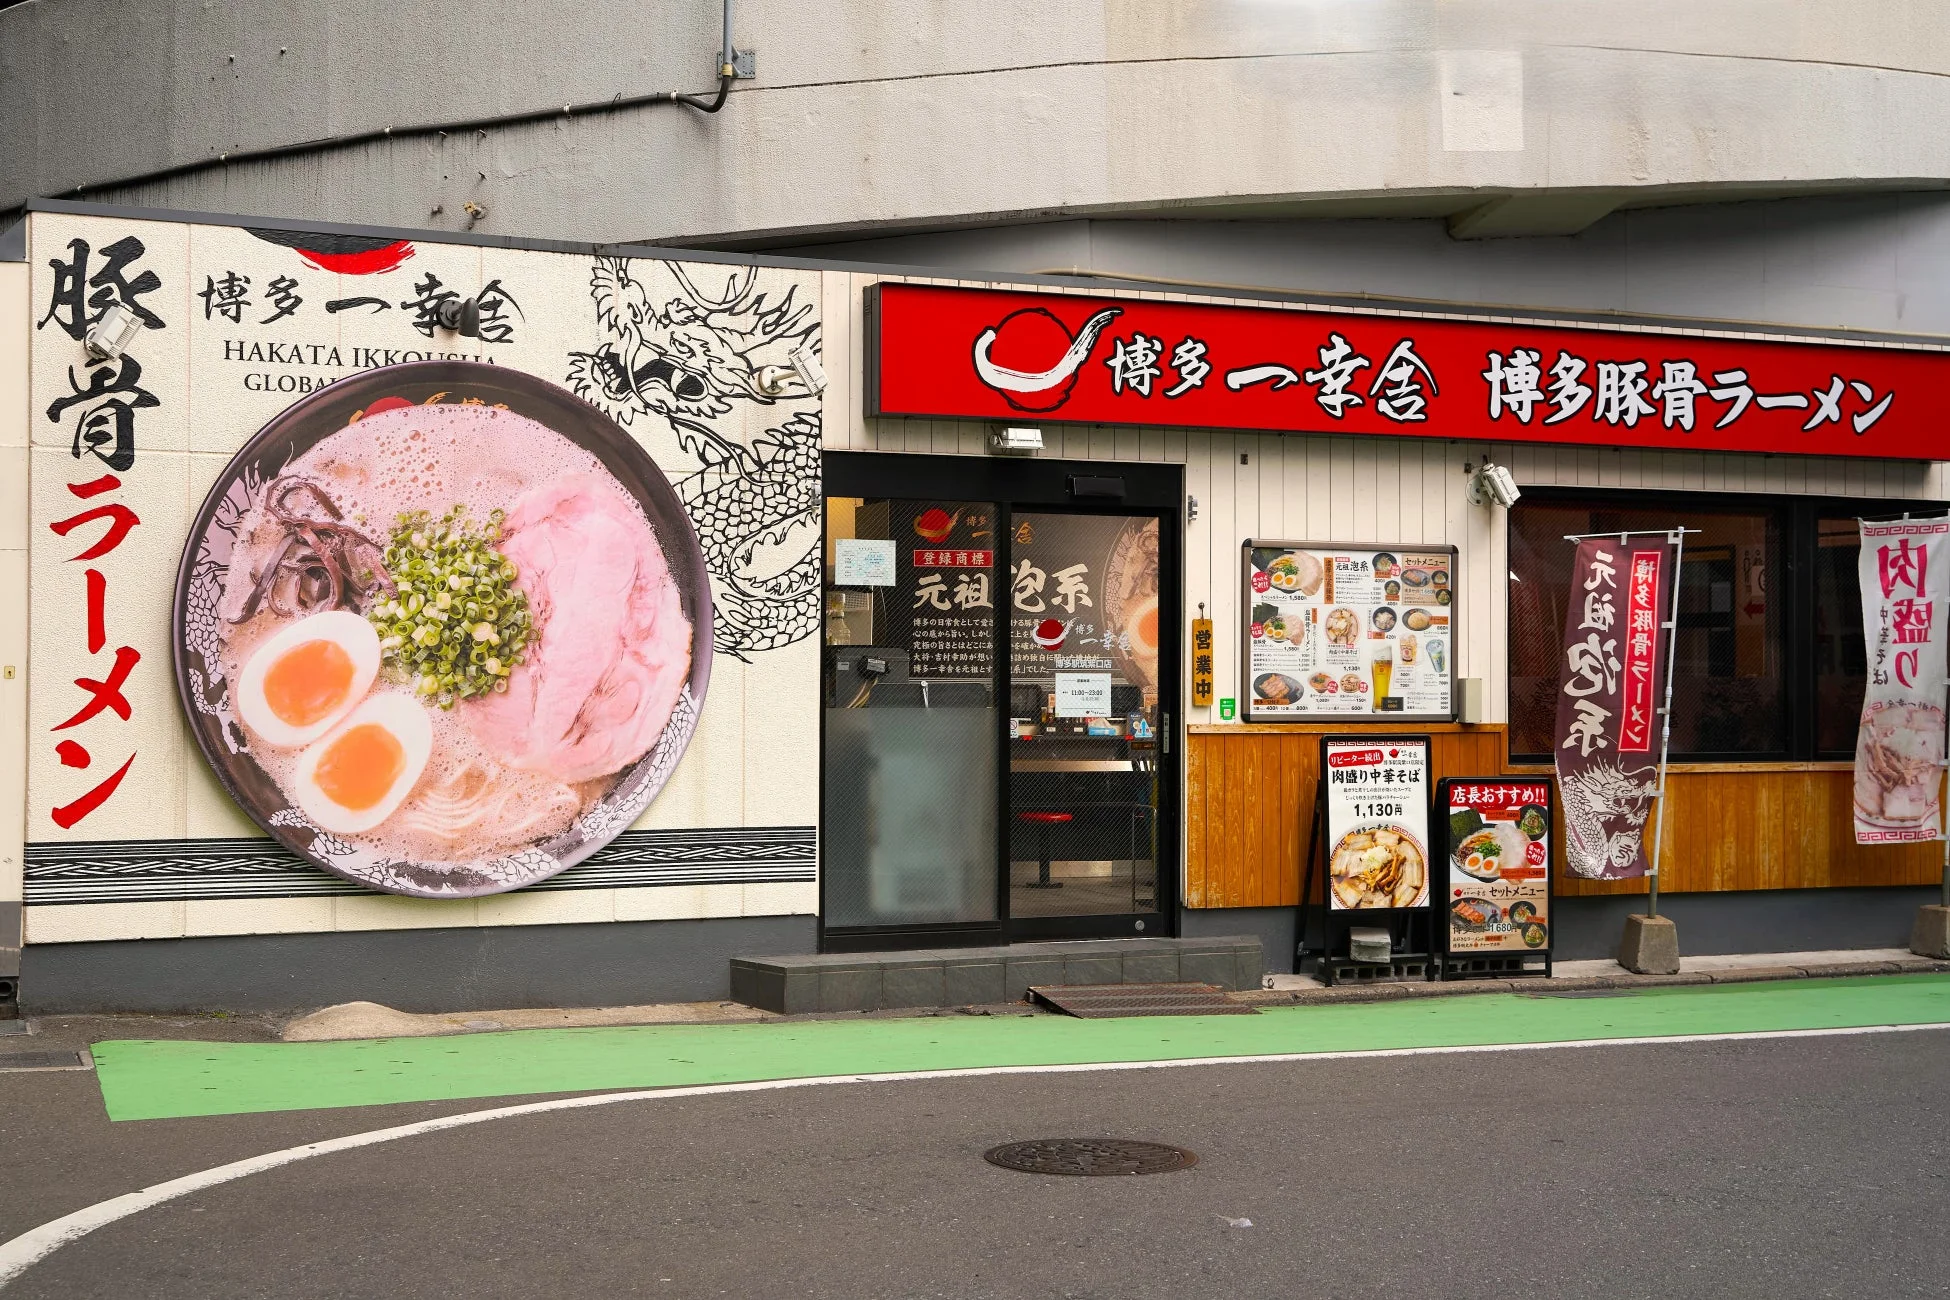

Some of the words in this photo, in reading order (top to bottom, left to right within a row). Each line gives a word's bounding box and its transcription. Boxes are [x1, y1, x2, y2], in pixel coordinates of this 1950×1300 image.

[223, 340, 345, 367] HAKATA
[1106, 334, 1439, 422] 博多一幸舎
[1482, 349, 1894, 434] 博多豚骨ラーメン
[923, 551, 984, 565] 登録商標
[1405, 557, 1447, 566] セットメニュー
[1075, 624, 1095, 635] 博多
[1196, 629, 1212, 699] 営業中
[1331, 752, 1381, 765] リピーター続出
[1332, 768, 1421, 785] 肉盛り中華そば
[1452, 786, 1546, 804] 店長おすすめ!!
[1489, 886, 1545, 897] セットメニュー
